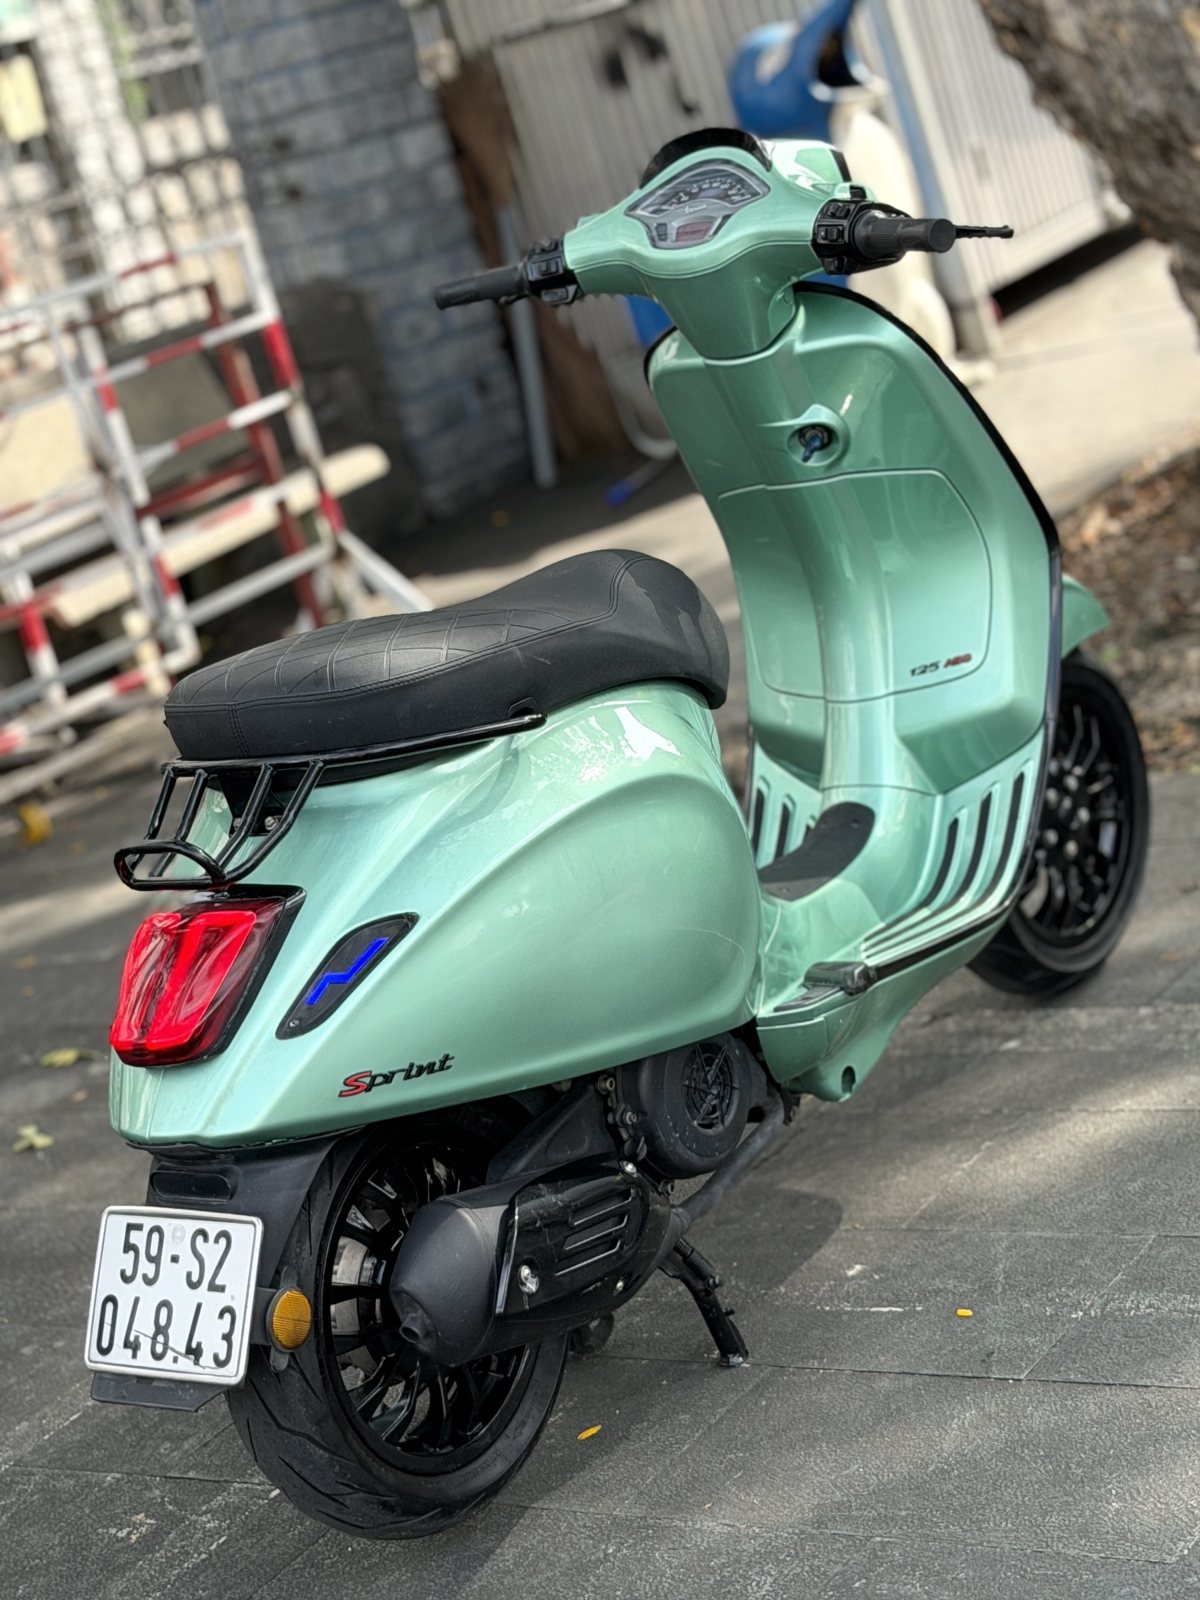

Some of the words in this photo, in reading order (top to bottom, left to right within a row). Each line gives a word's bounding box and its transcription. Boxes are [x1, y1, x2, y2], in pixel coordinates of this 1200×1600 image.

[909, 660, 940, 677] 125
[338, 1053, 455, 1098] Sprint
[120, 1222, 233, 1293] 59-S2
[96, 1294, 237, 1368] 048.43
